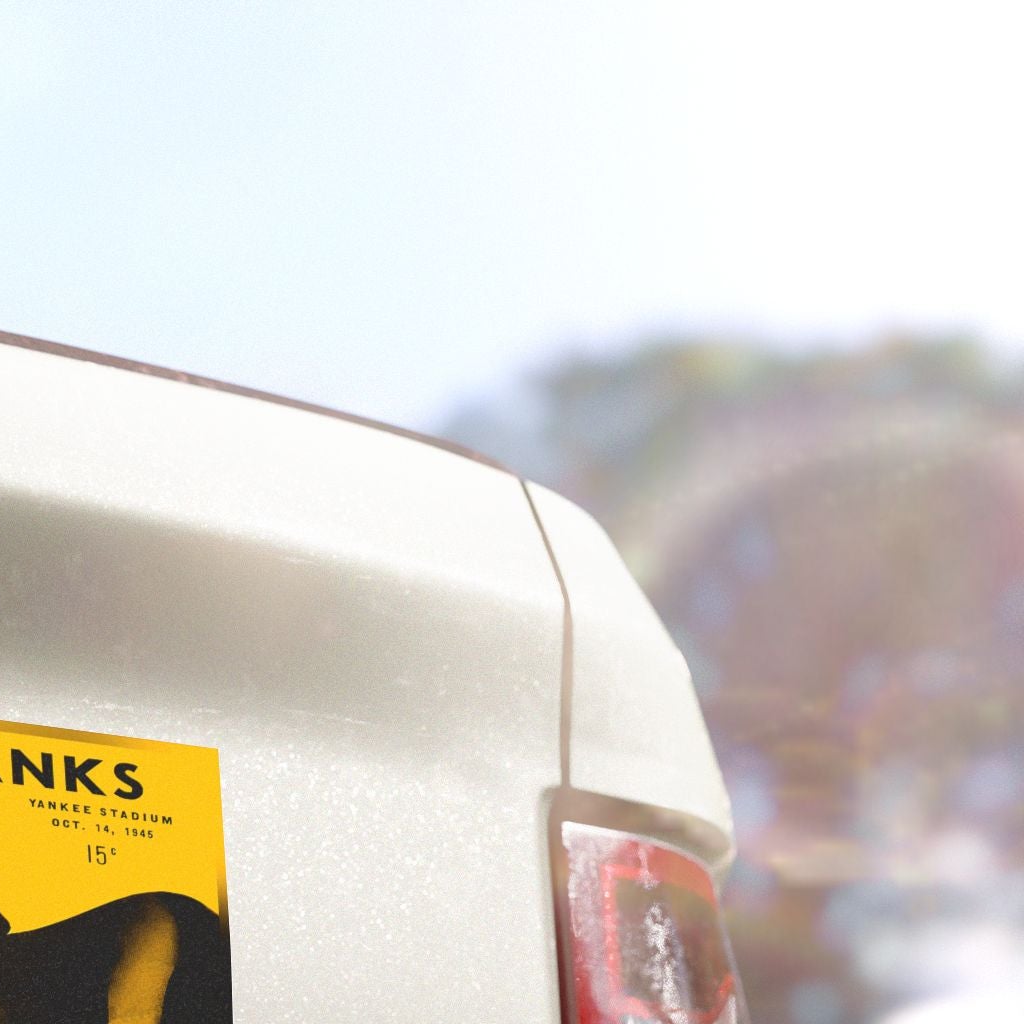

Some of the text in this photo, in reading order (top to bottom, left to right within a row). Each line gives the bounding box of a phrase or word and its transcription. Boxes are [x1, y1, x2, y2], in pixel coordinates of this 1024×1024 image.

[29, 798, 173, 825] YANKEE STADIUM
[51, 818, 154, 839] OCT. 14, 1945
